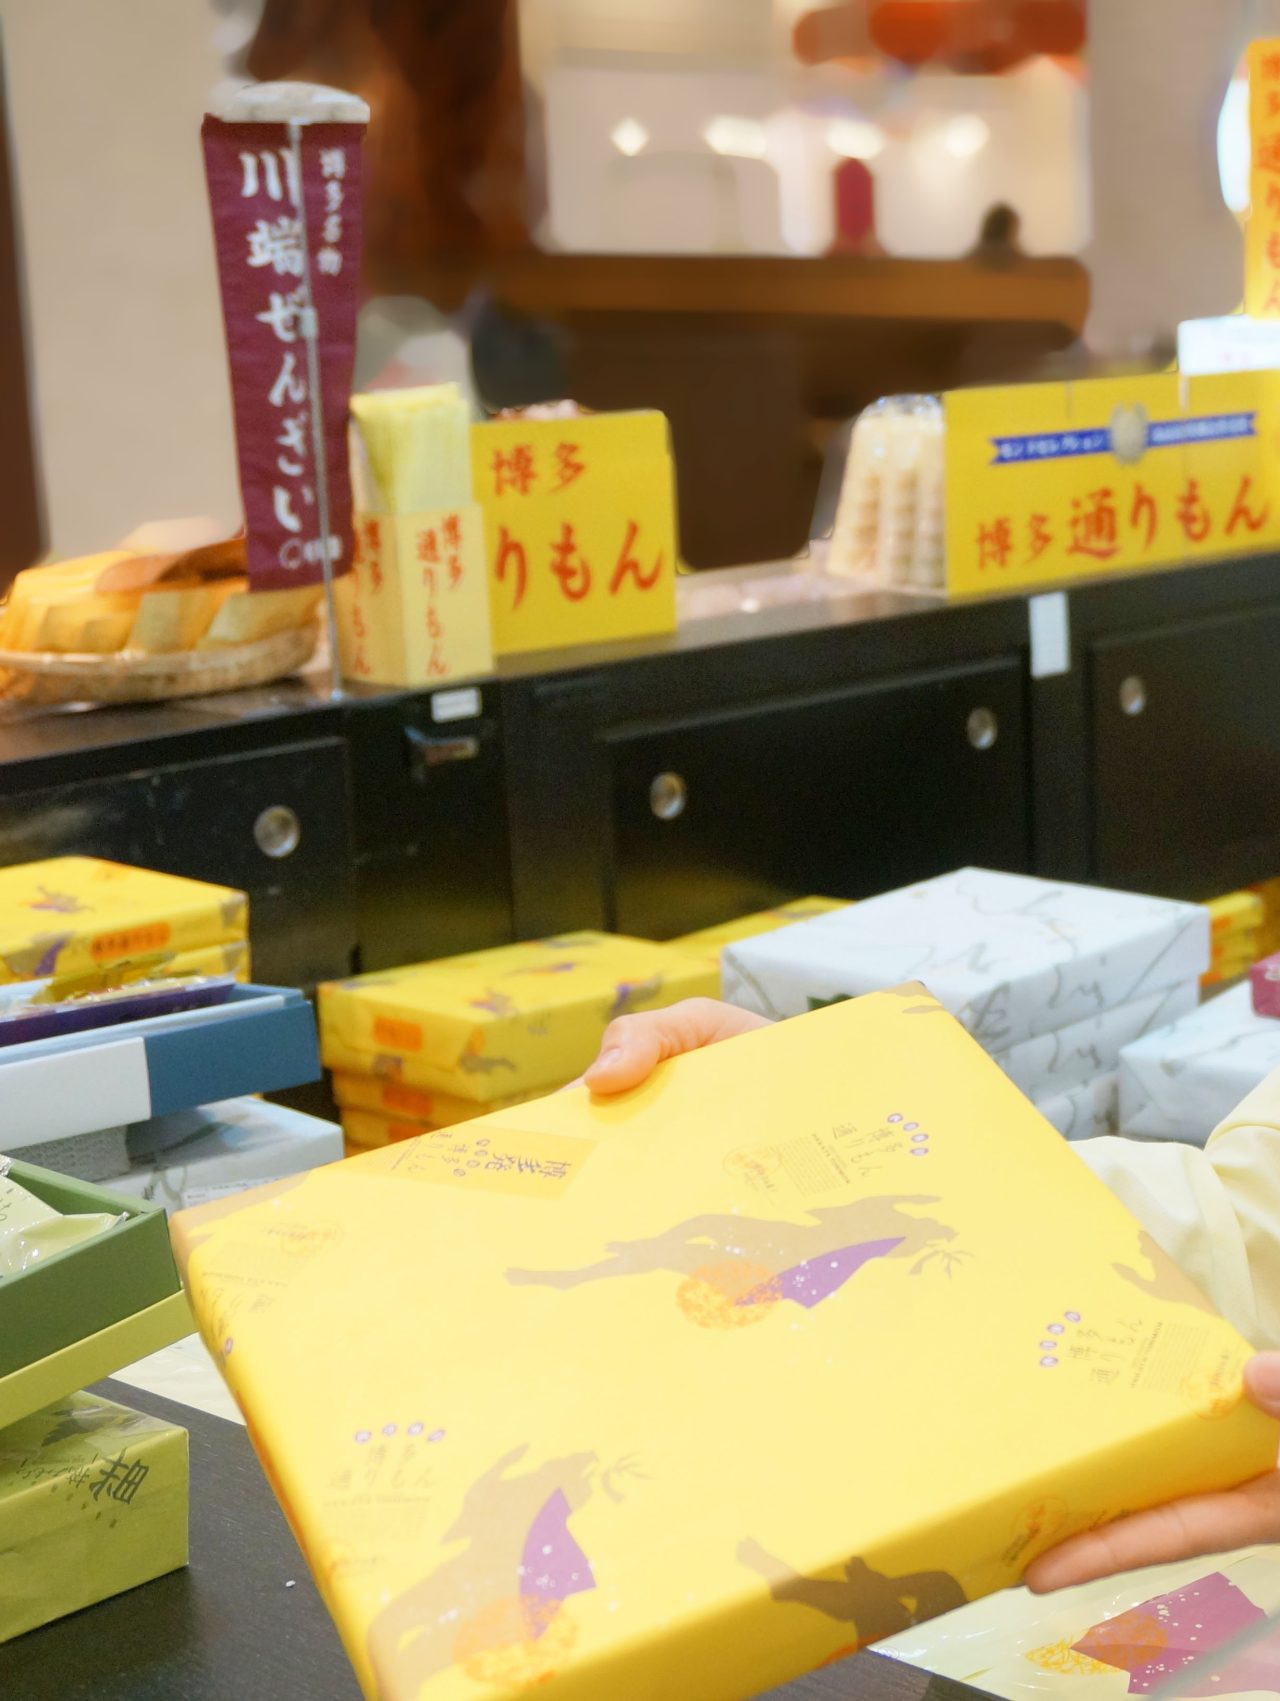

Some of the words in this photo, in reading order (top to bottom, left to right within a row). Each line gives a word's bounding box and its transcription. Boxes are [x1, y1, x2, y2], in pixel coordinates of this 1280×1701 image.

[239, 147, 318, 533] 川端ぜんざい
[491, 440, 588, 497] 博多
[976, 473, 1272, 572] 博多通りもん
